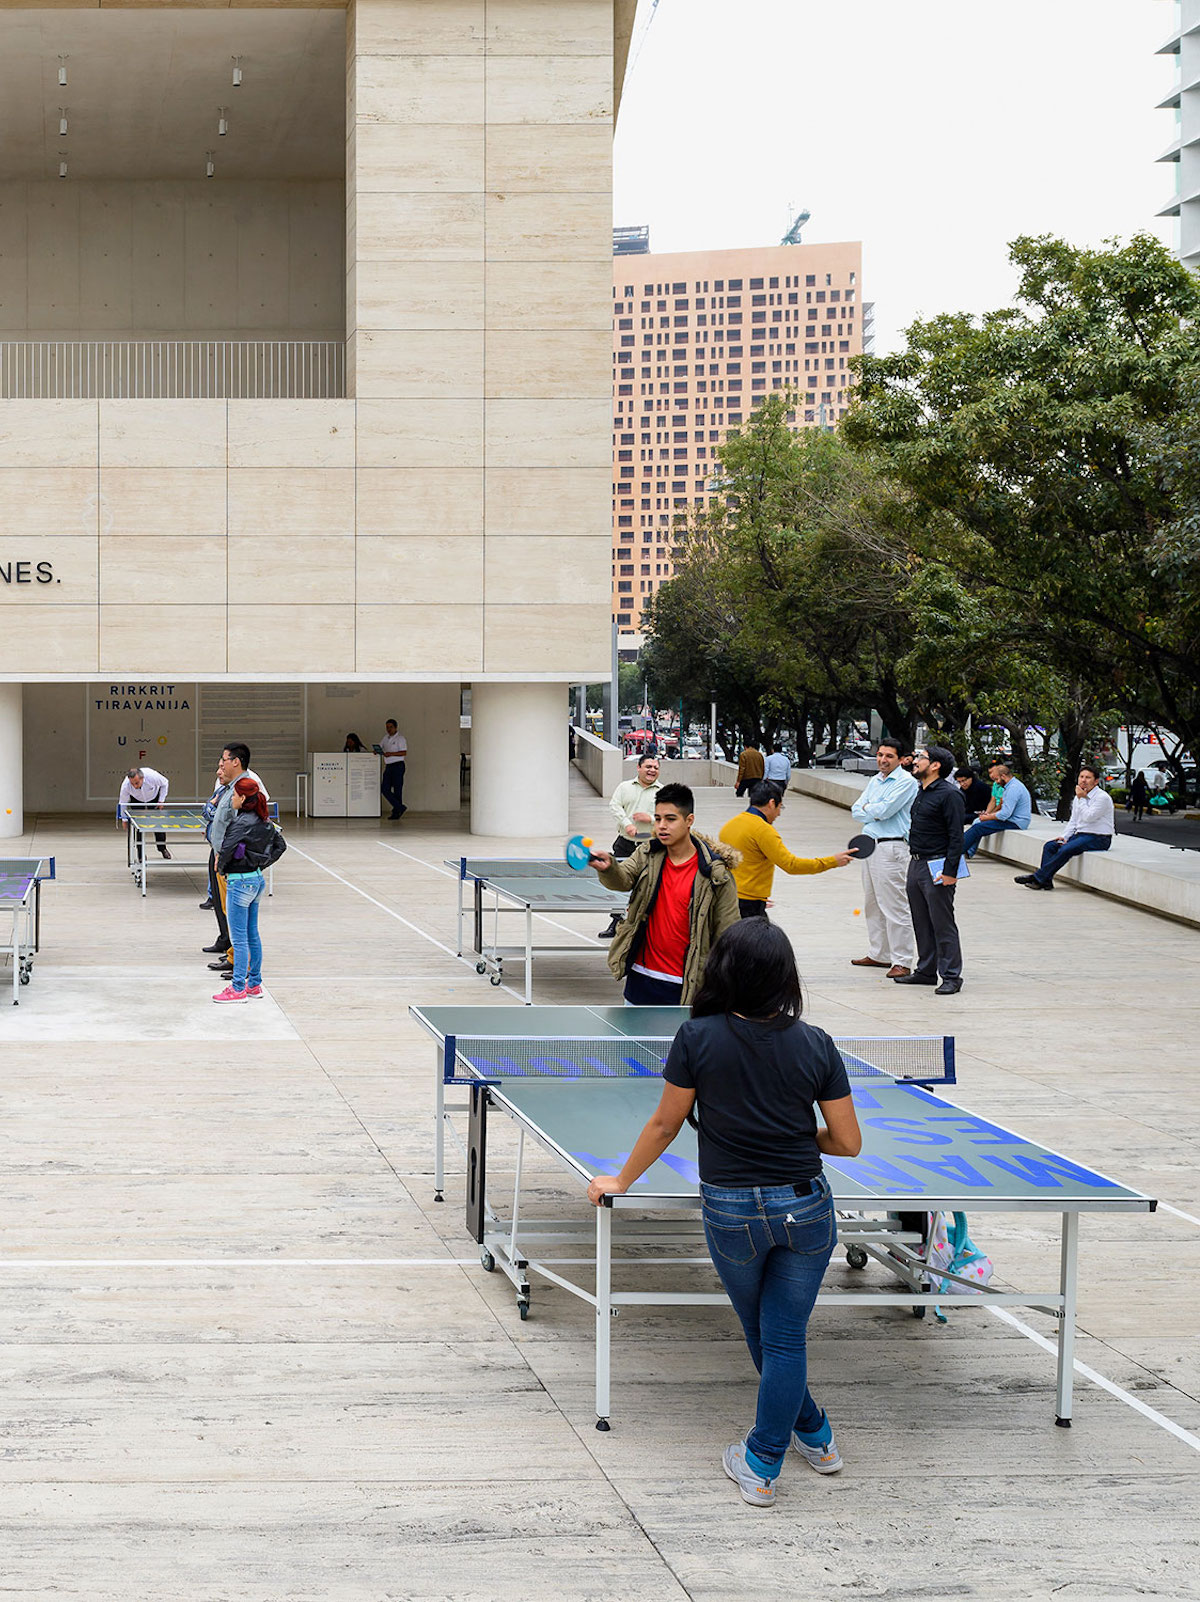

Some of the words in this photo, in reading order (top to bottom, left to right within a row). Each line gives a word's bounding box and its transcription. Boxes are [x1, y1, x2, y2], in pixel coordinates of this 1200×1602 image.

[110, 685, 175, 696] RIRKRIT
[95, 700, 190, 710] TIRAVANIJA
[864, 1116, 1032, 1145] ES
